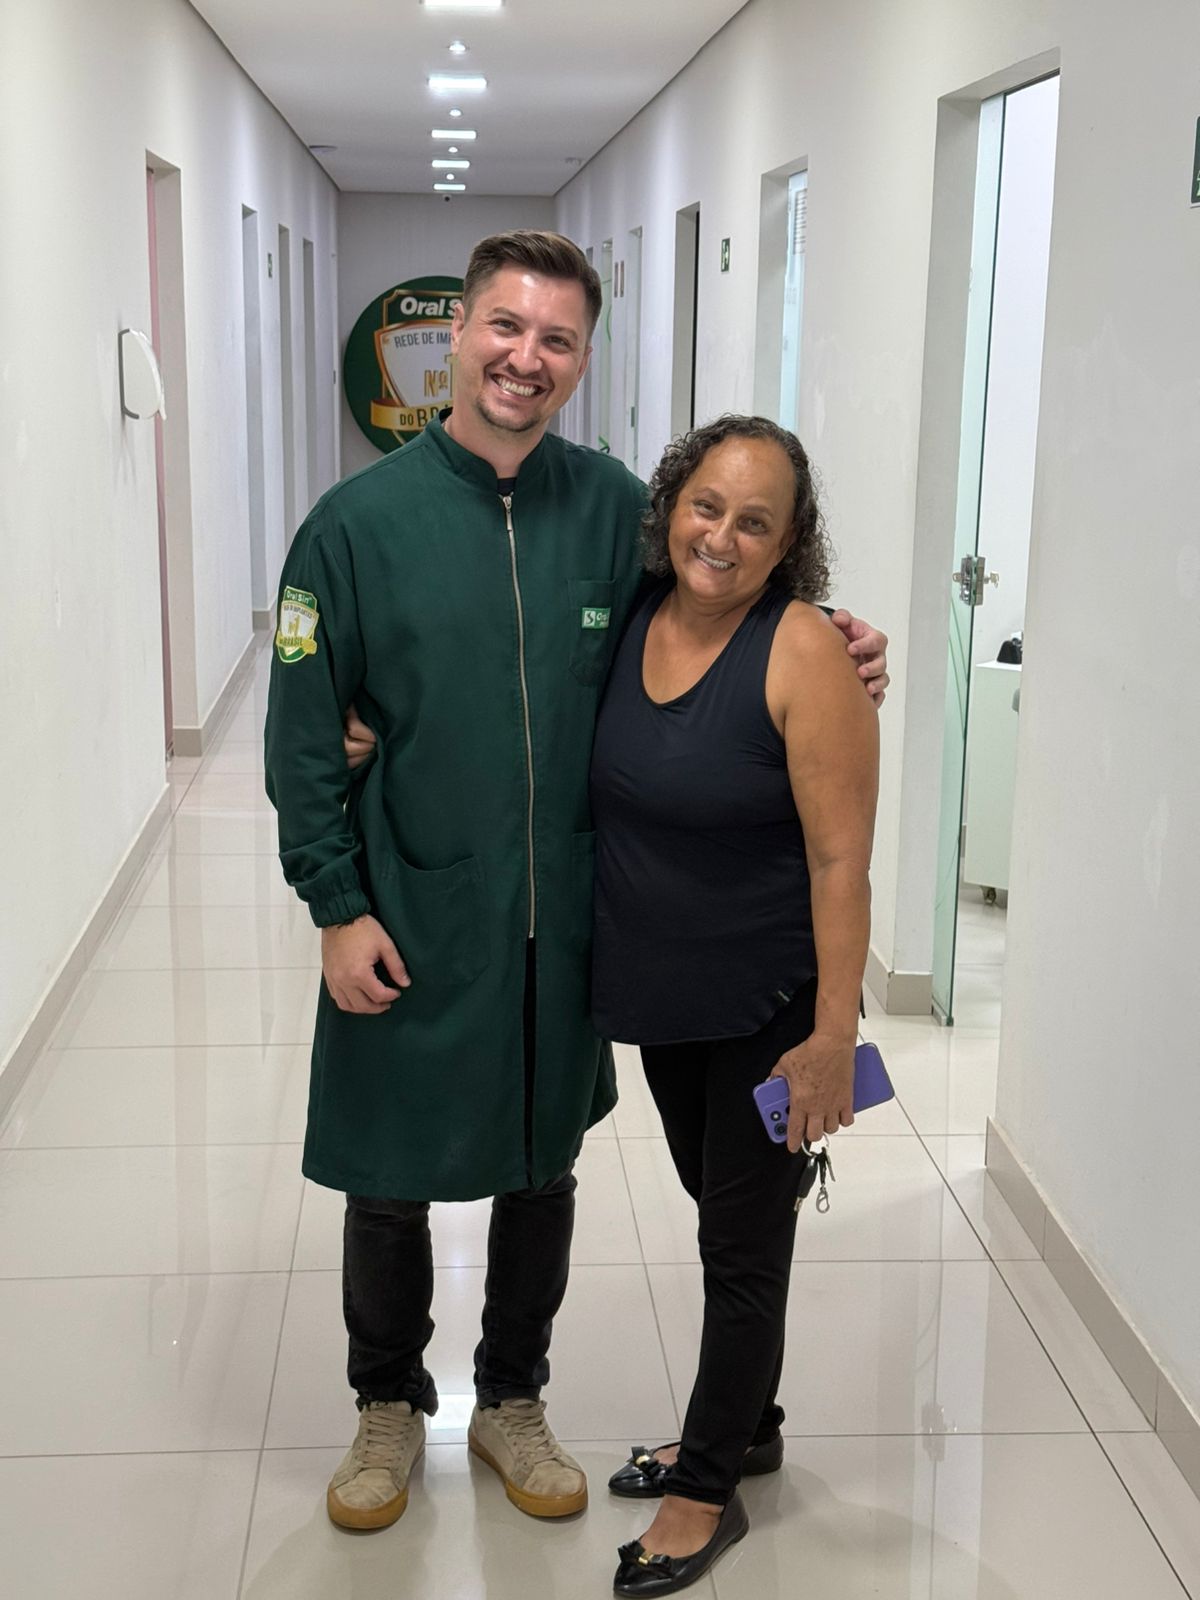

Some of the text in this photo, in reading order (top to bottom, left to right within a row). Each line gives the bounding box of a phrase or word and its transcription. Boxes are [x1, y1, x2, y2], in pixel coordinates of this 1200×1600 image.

[400, 296, 462, 317] Oral S
[394, 332, 420, 348] REDE
[421, 331, 434, 345] DE
[400, 413, 414, 426] DO
